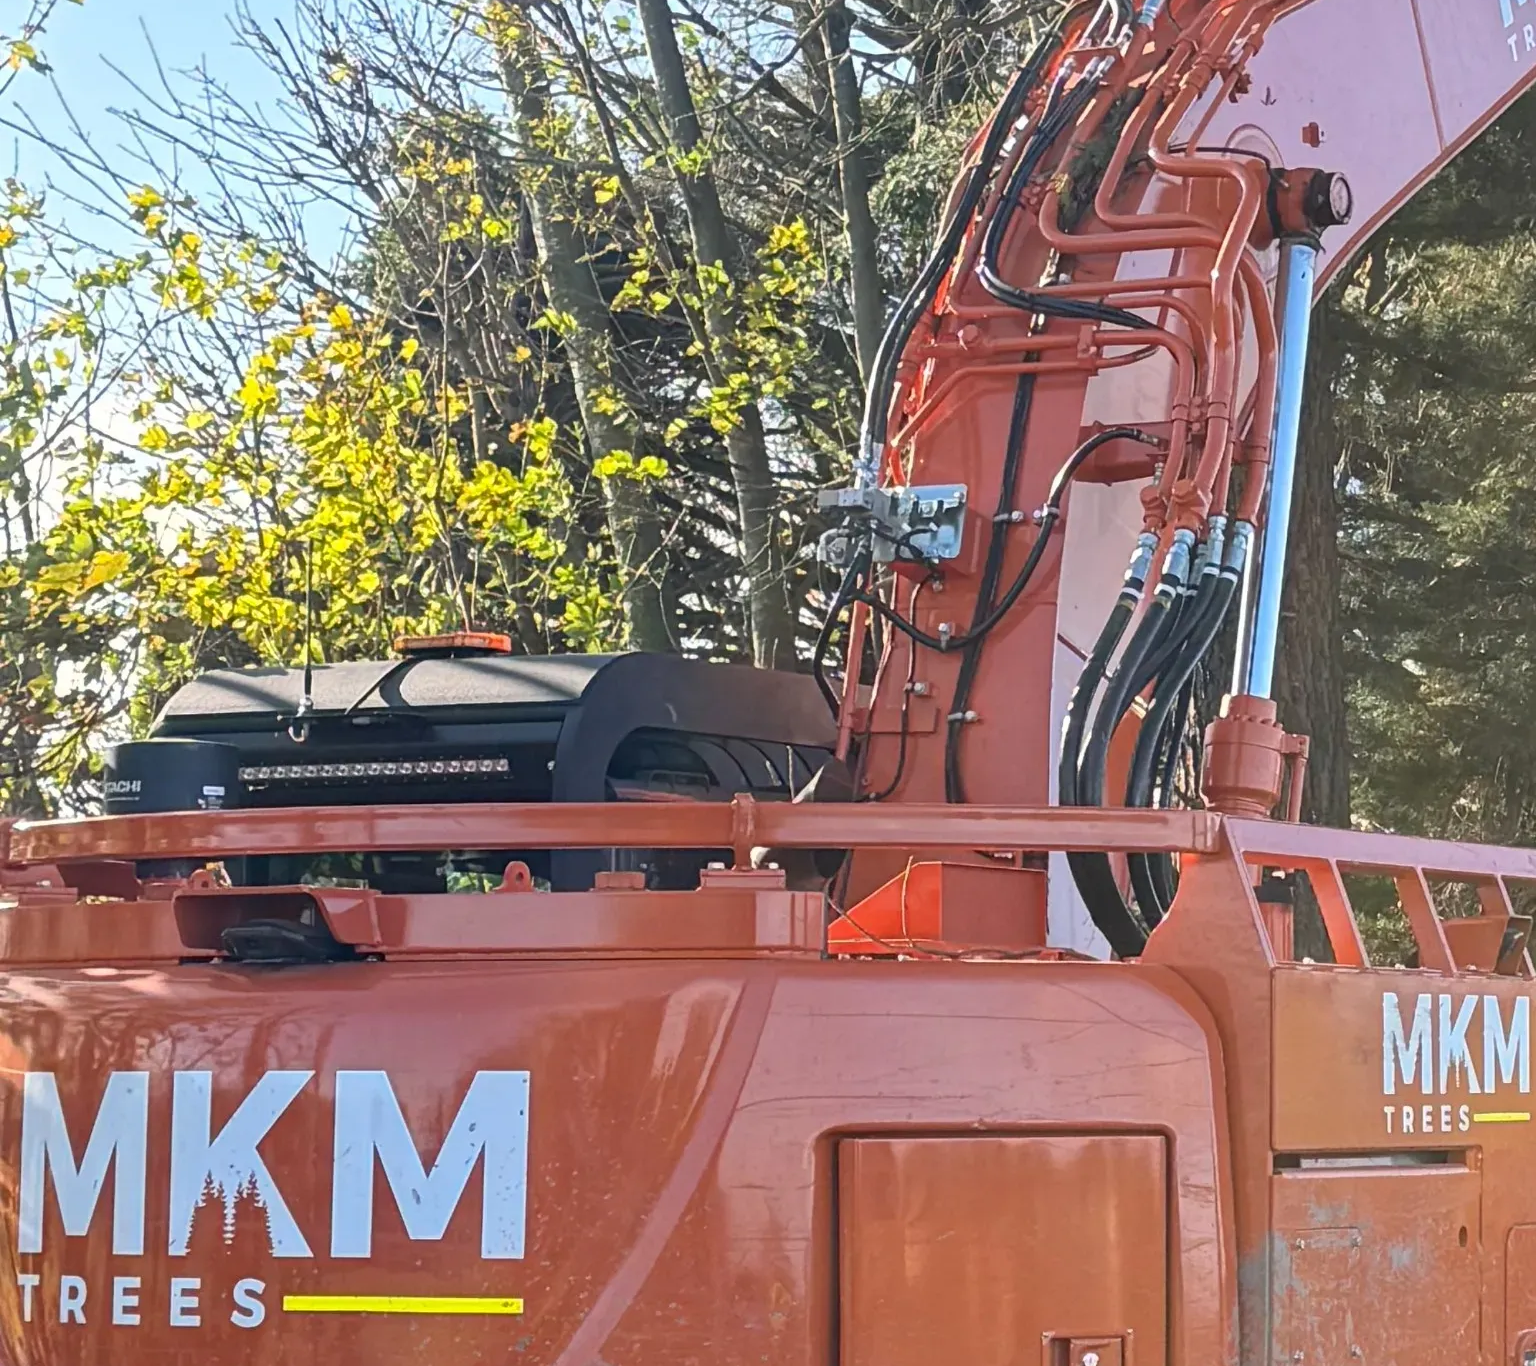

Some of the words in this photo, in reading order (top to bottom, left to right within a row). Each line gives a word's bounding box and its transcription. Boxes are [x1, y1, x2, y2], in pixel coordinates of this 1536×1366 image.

[1383, 992, 1530, 1094] MKM
[1383, 1104, 1470, 1133] TREES
[17, 1070, 530, 1259] MKM
[17, 1274, 266, 1327] TREES
